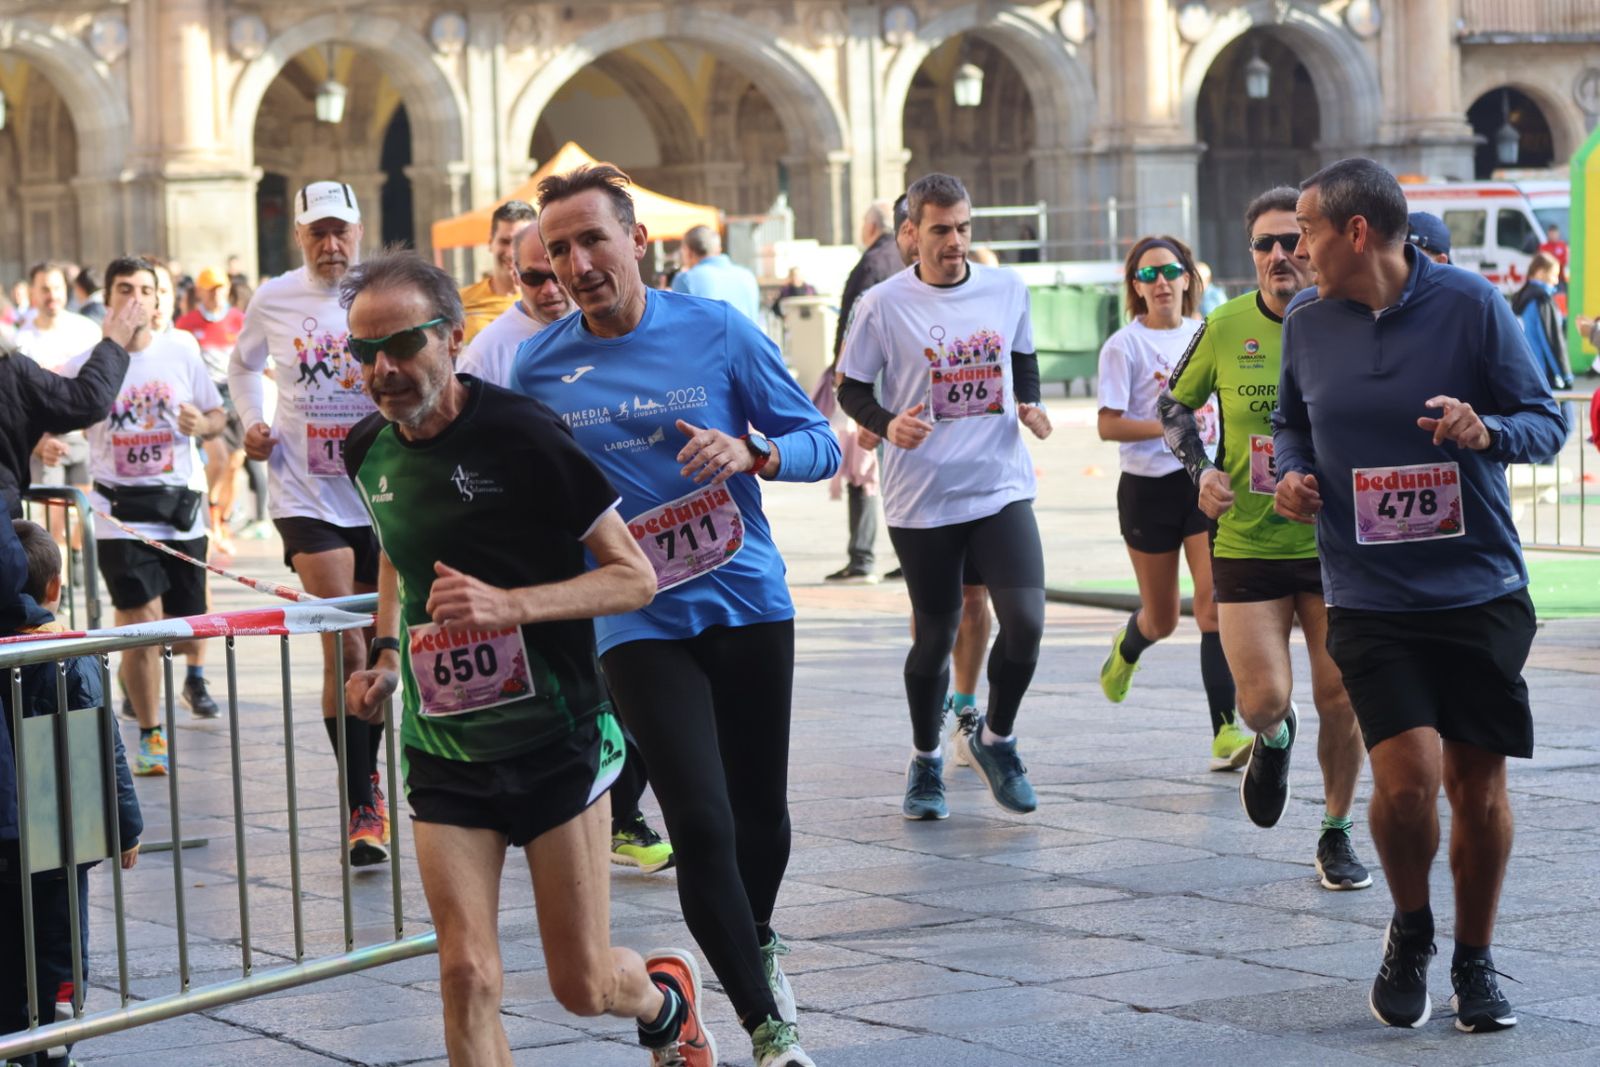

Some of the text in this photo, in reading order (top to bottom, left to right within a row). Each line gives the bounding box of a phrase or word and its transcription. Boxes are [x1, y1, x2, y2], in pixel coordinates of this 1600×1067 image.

[666, 386, 708, 406] 2023
[948, 381, 987, 403] 696
[1238, 385, 1279, 396] CORR
[571, 408, 610, 421] MEDIA
[633, 410, 658, 418] CIUDAD
[670, 402, 708, 411] SALAMANCA
[127, 445, 162, 464] 665
[604, 438, 648, 452] LABORAL
[1355, 468, 1458, 492] bedunia
[627, 488, 731, 540] bedunia
[1378, 489, 1437, 518] 478
[655, 514, 718, 560] 711
[434, 643, 498, 686] 650
